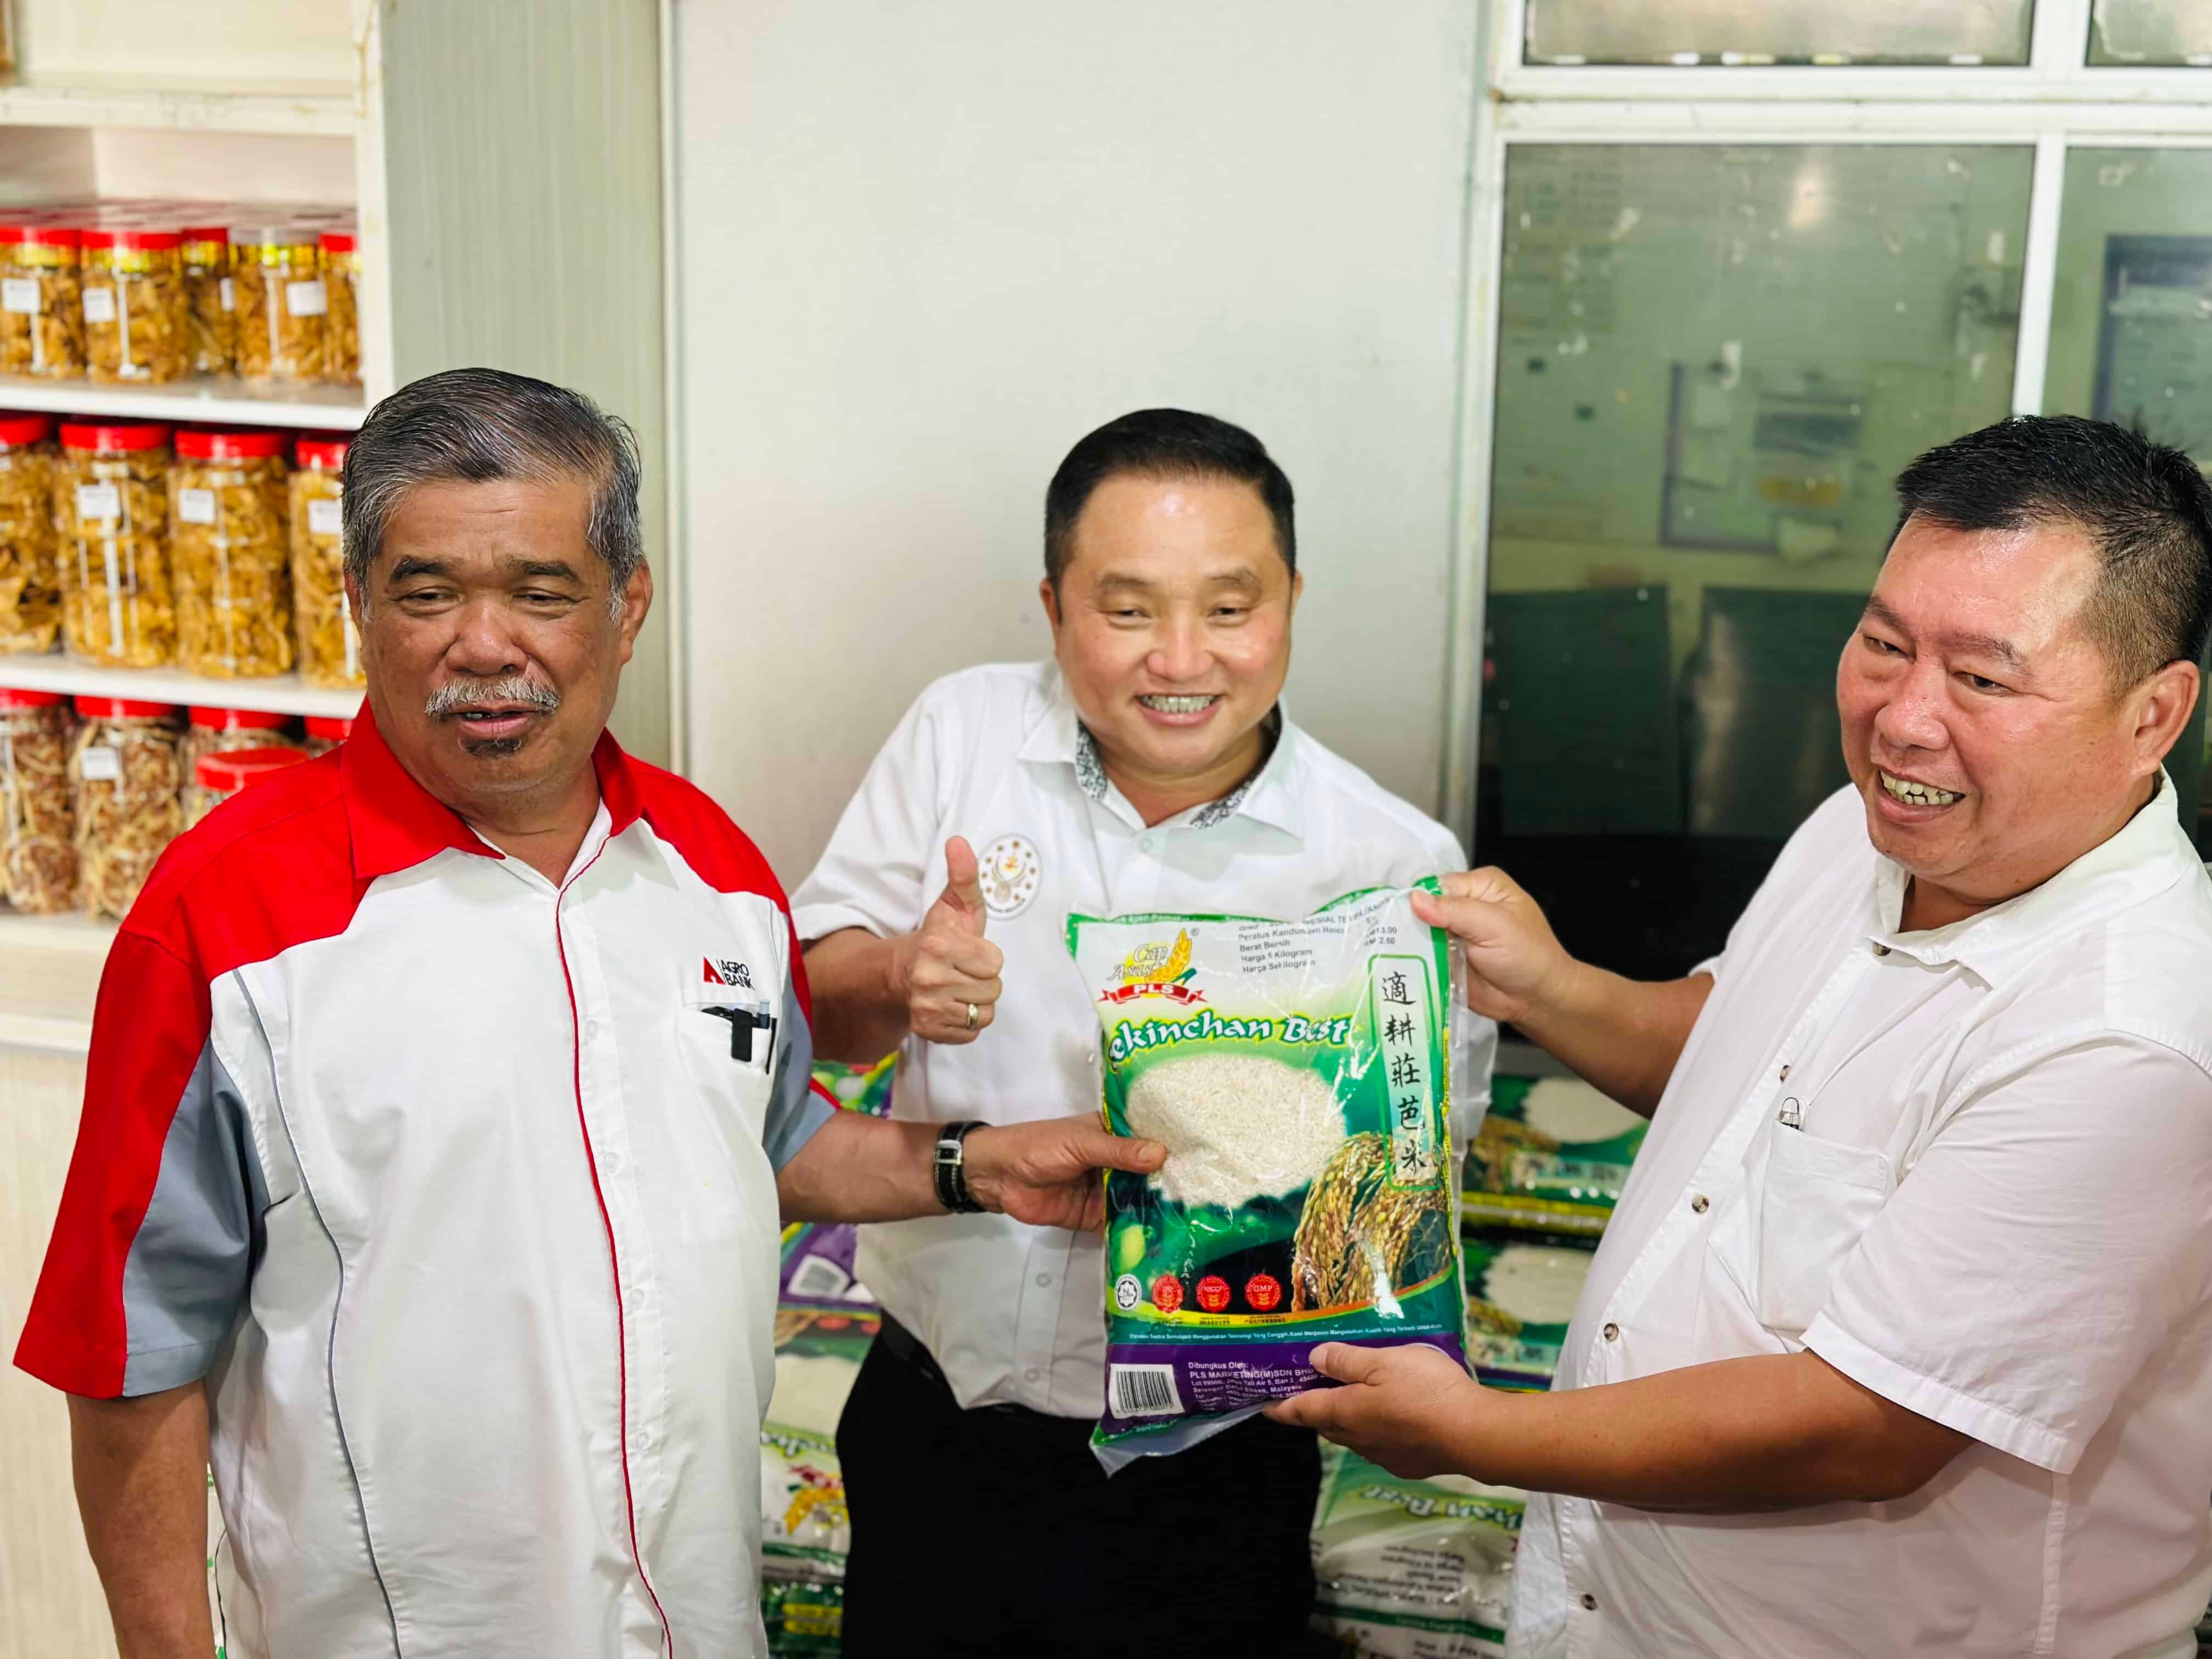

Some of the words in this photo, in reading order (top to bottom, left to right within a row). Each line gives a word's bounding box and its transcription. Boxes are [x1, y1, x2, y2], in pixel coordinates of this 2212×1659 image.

[1238, 932, 1270, 941] Peratus
[1239, 944, 1262, 952] Berat
[1263, 939, 1291, 949] Bersih
[1241, 953, 1266, 963] Harga
[1274, 949, 1313, 958] Kilogram
[721, 959, 749, 977] AGRO
[1106, 964, 1154, 981] Asas
[1243, 964, 1267, 974] Harga
[724, 973, 755, 991] BANK
[1133, 984, 1174, 995] PLS
[1108, 1009, 1272, 1063] ekinchan
[1282, 1014, 1353, 1045] Best
[1381, 970, 1427, 1176] 適耕莊芭米
[1253, 1284, 1273, 1293] GMP
[1188, 1362, 1227, 1370] Dibungkus
